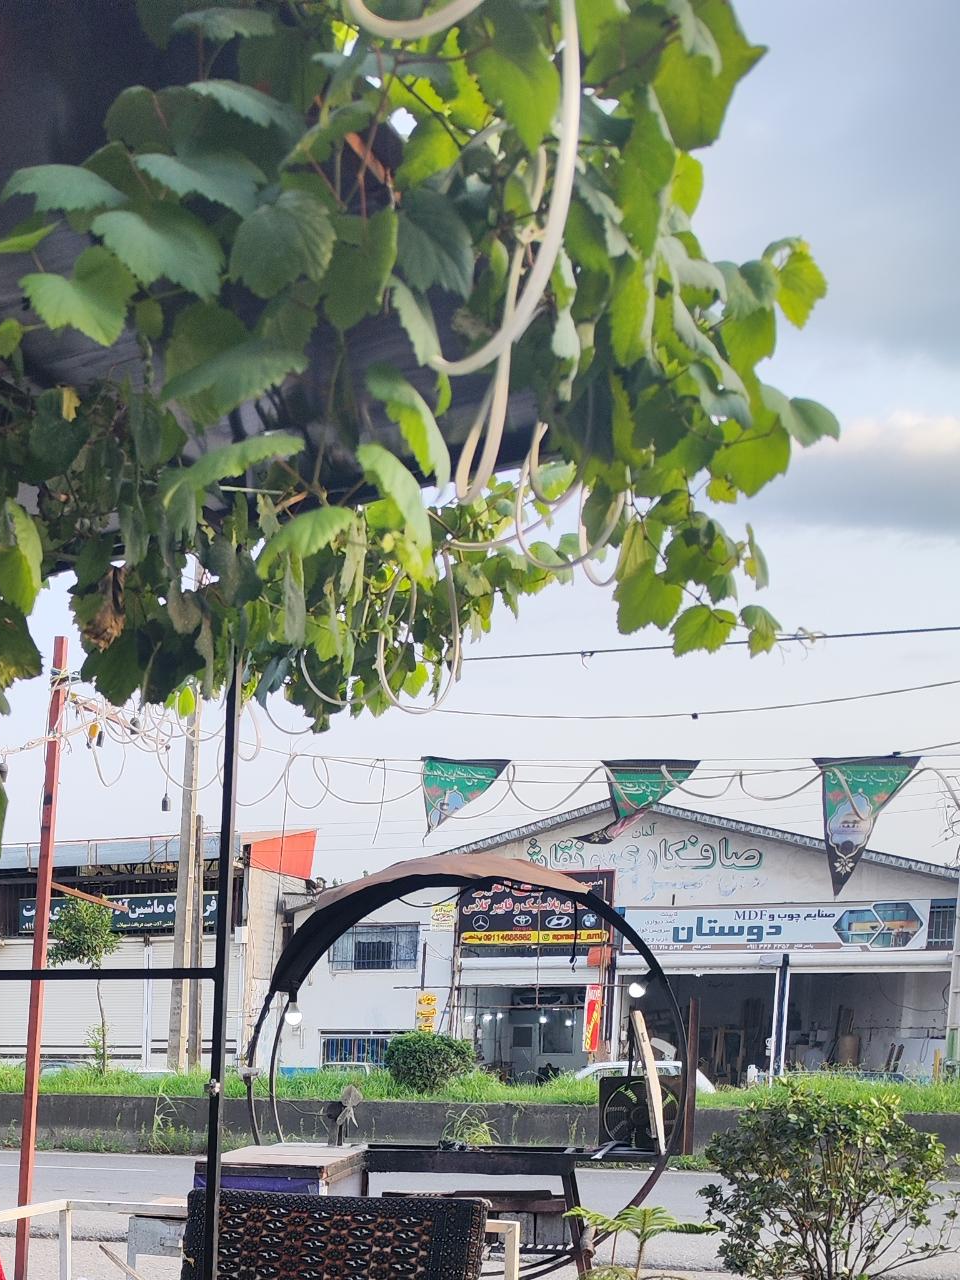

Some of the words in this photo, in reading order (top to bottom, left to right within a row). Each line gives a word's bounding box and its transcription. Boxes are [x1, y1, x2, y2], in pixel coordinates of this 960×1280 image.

[128, 899, 164, 919] ماشین
[462, 898, 492, 915] گلاس
[489, 897, 514, 914] فایبر
[512, 902, 521, 914] و
[521, 897, 561, 915] پلاستیک
[734, 909, 769, 921] MDF
[777, 913, 801, 923] چوب
[803, 909, 836, 921] صنایع
[672, 916, 783, 944] دوستان
